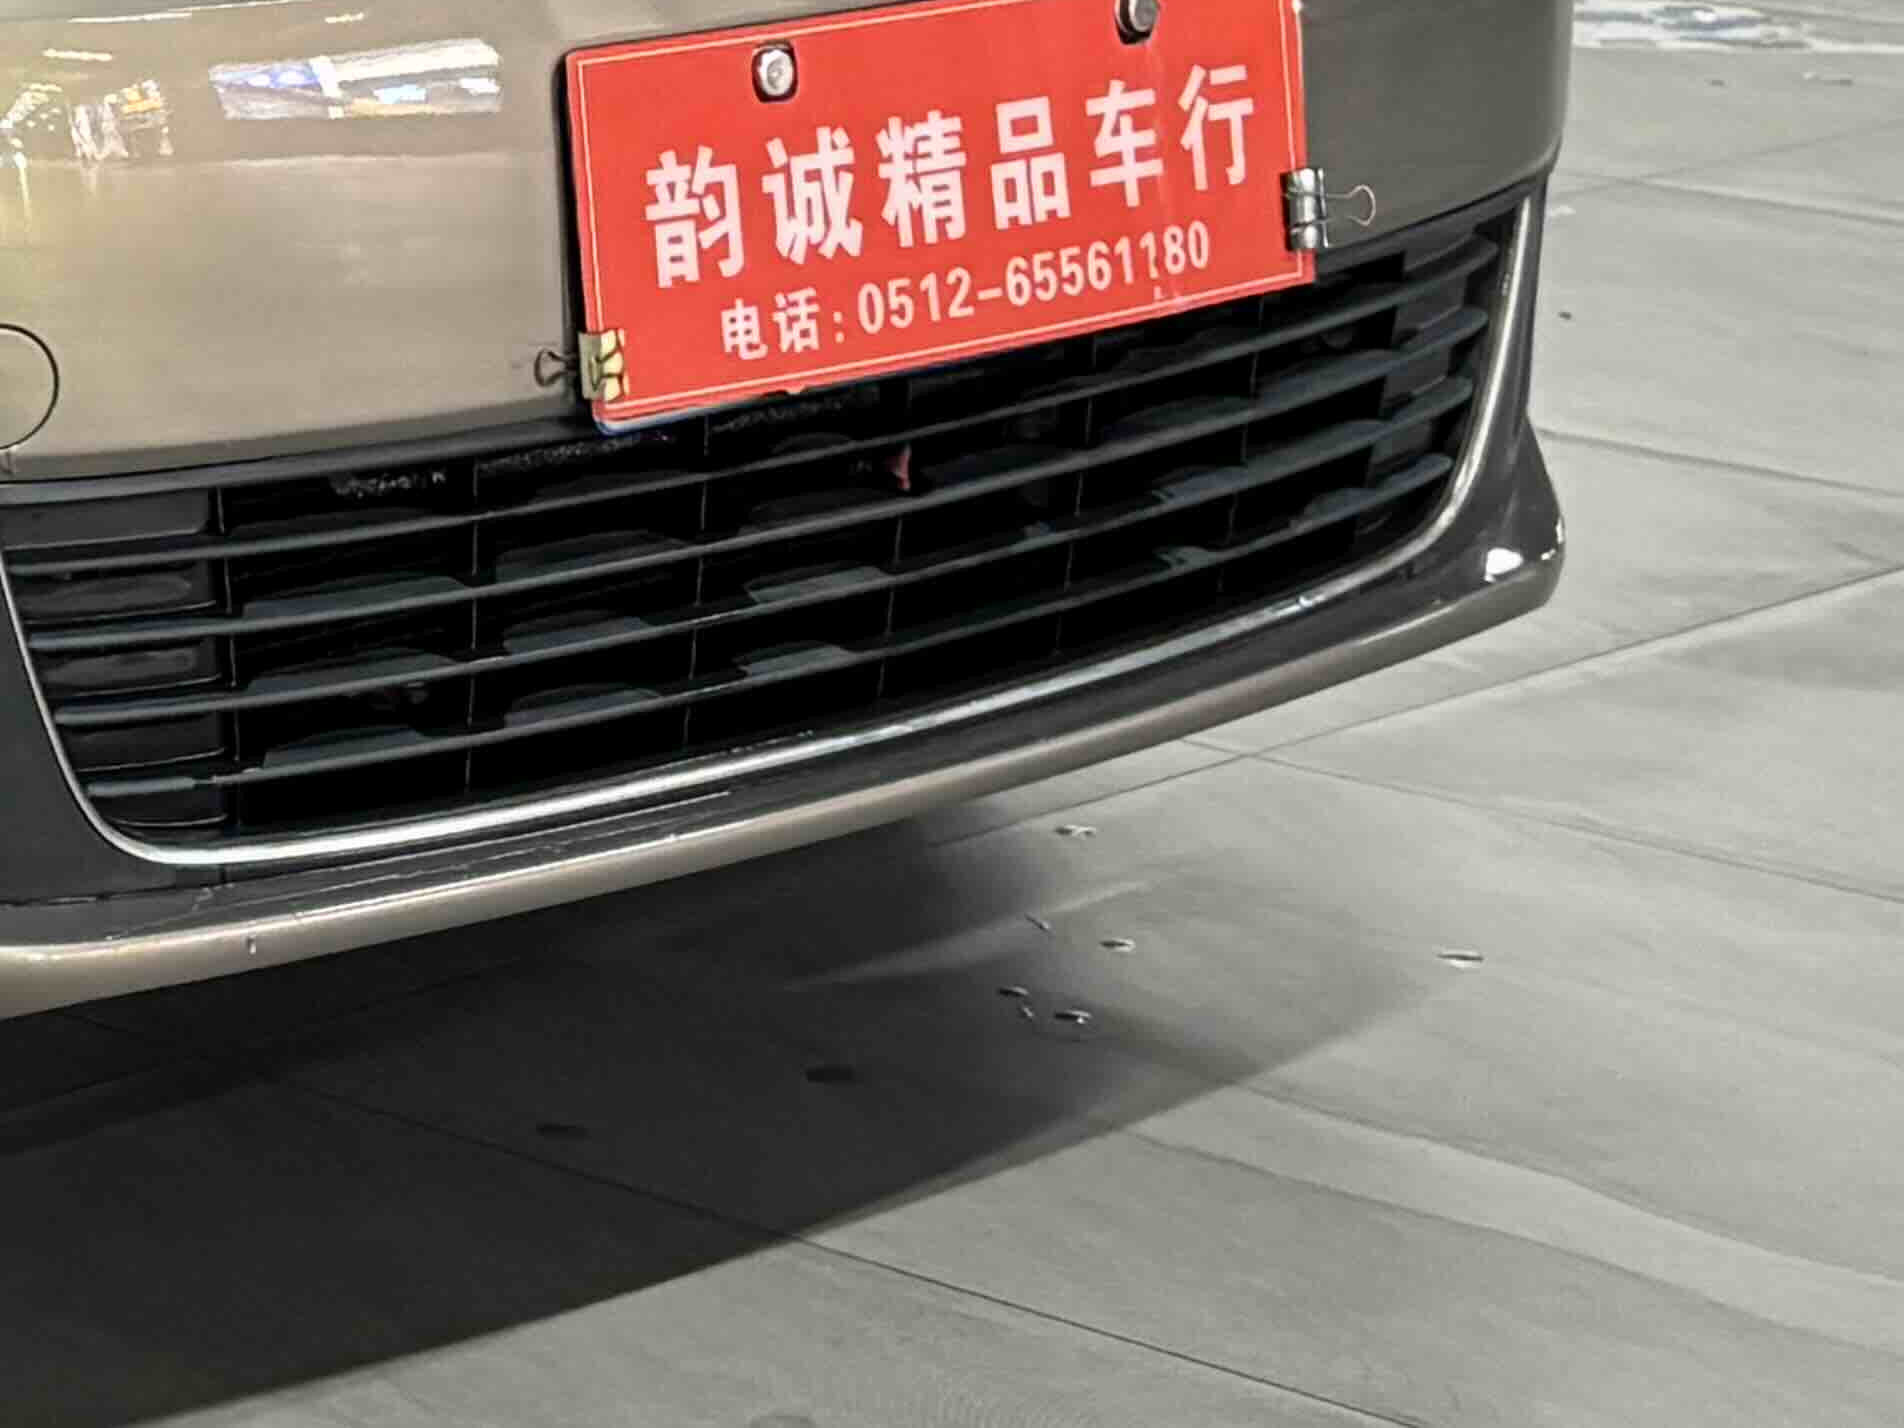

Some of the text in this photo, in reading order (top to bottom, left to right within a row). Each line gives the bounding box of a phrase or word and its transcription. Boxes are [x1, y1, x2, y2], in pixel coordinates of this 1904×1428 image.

[644, 62, 1256, 288] 韵诚精品车行
